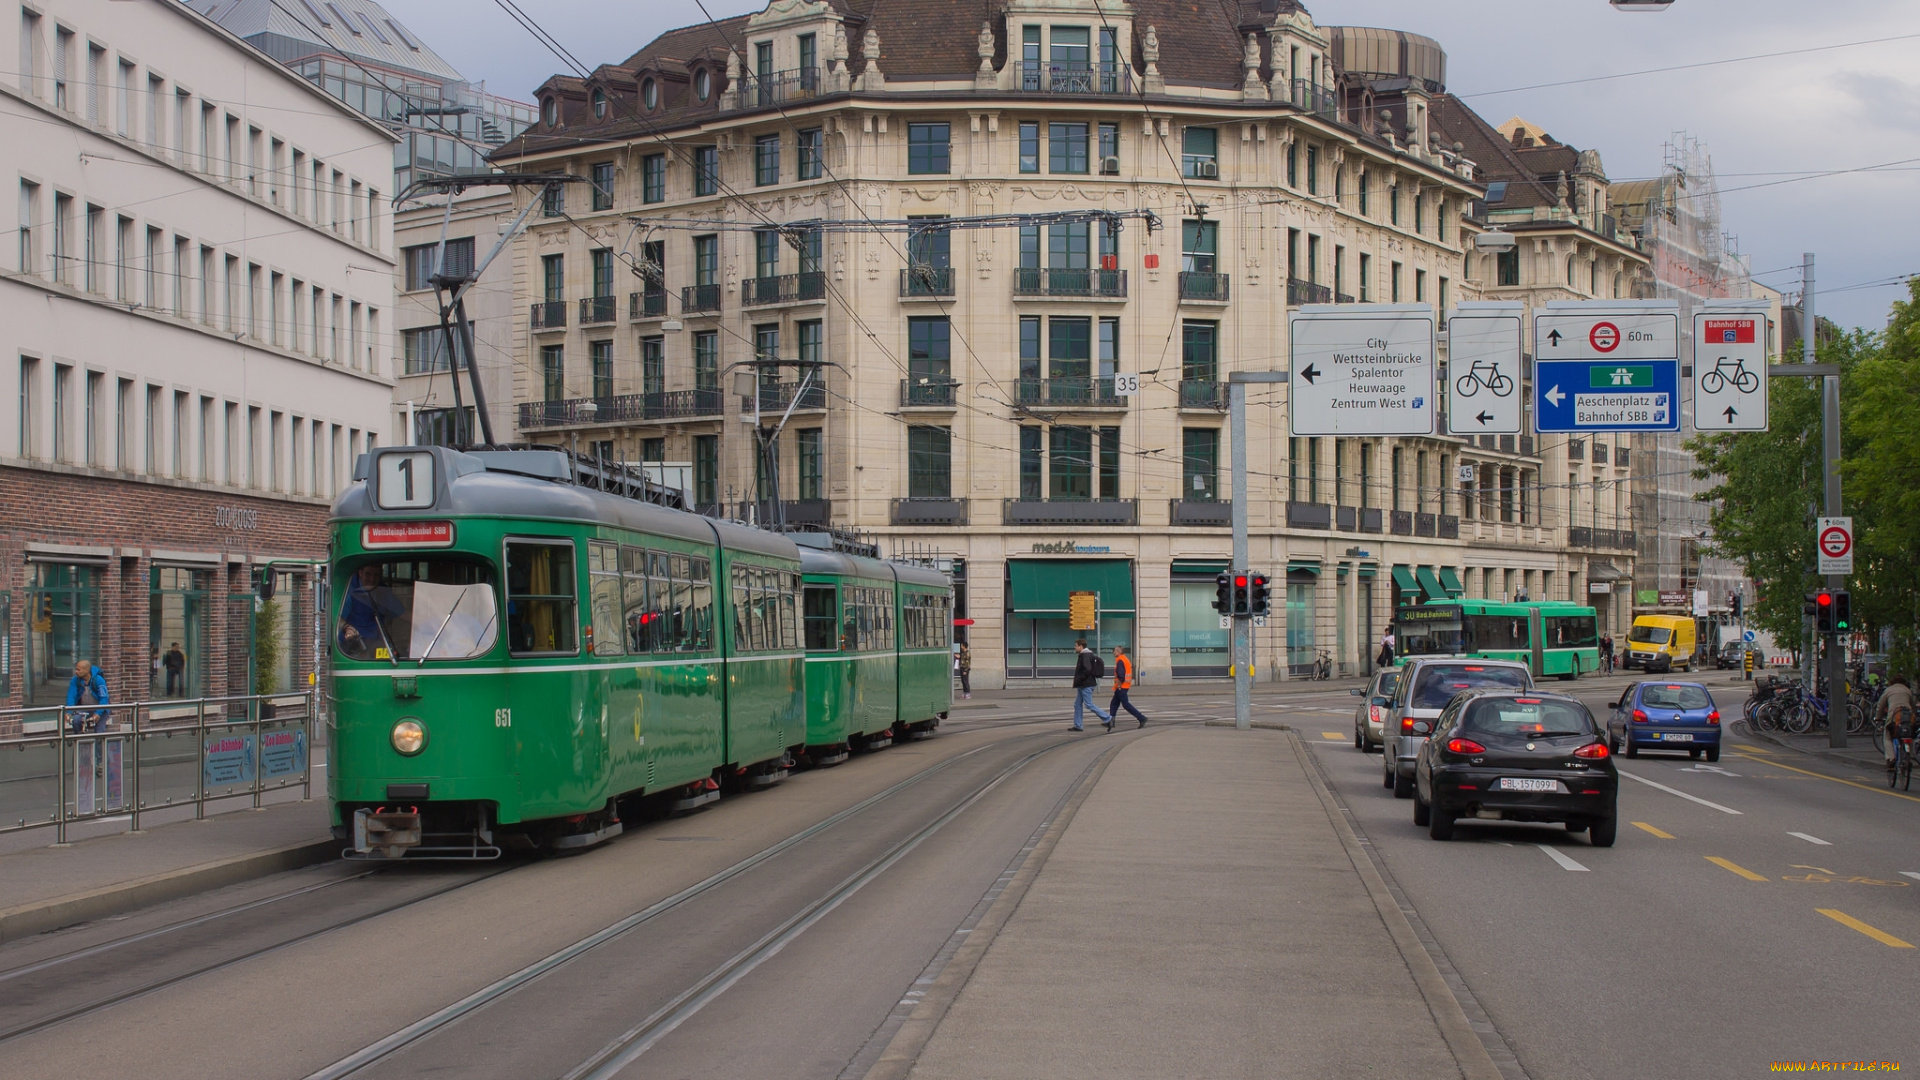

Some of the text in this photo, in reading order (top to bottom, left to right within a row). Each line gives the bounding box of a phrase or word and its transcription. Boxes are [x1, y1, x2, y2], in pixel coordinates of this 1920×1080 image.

[1708, 320, 1751, 328] Bahnhof SBB
[1366, 338, 1389, 351] City
[1333, 353, 1422, 364] Wettsteinbrücke
[1351, 368, 1404, 380] Spalentor
[1117, 377, 1137, 391] 35
[1349, 383, 1406, 395] Heuwaage
[1331, 398, 1406, 409] Zentrum West
[1577, 395, 1650, 409] Aeschenplatz
[1578, 411, 1648, 422] Bahnhof SBB
[1460, 468, 1472, 479] 45
[398, 458, 414, 501] 1
[434, 526, 446, 535] SBB
[1222, 618, 1228, 627] S
[495, 708, 512, 728] 651
